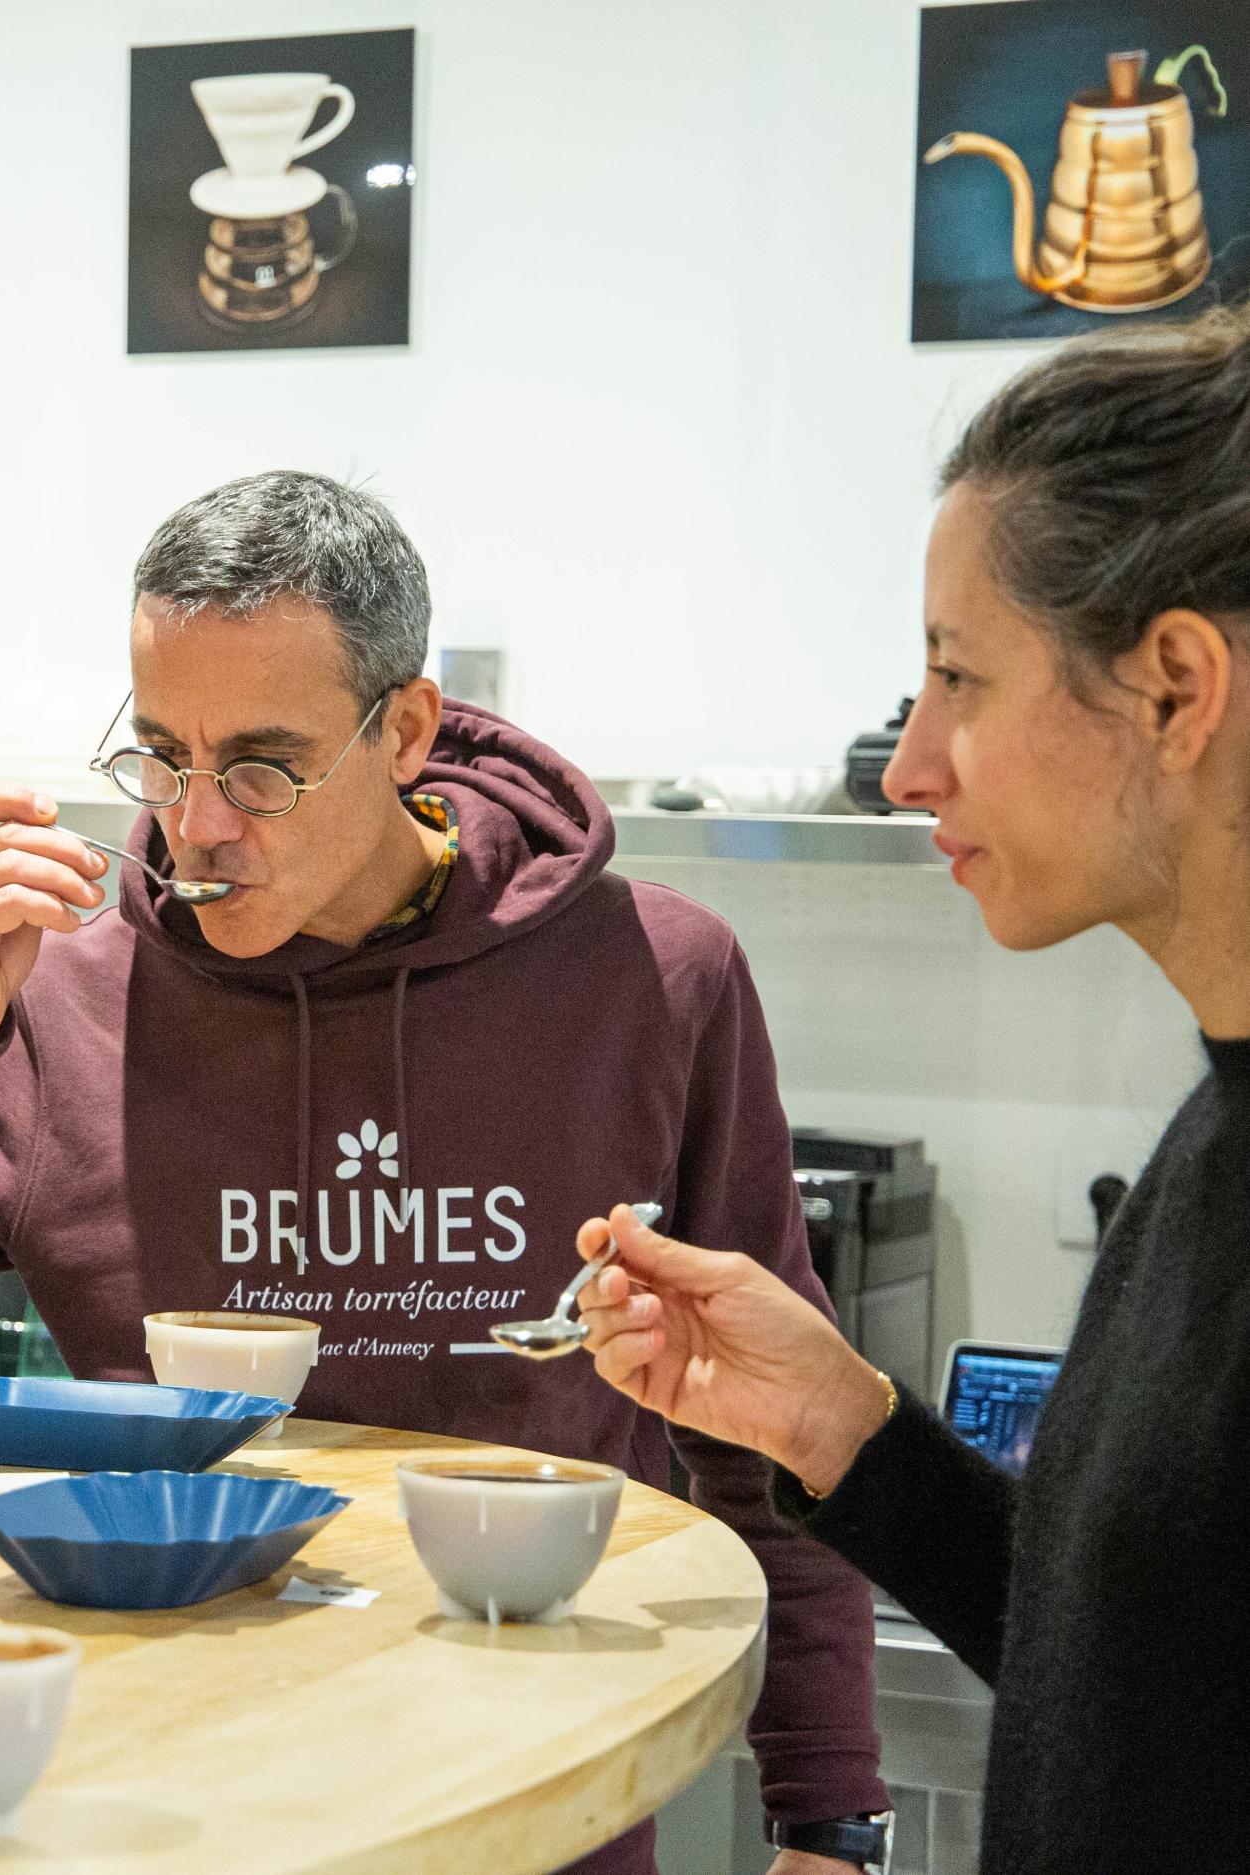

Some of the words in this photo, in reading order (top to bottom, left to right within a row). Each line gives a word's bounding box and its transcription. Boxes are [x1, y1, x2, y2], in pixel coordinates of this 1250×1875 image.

[221, 1185, 527, 1266] BRUMES
[222, 1279, 333, 1312] Artisan
[344, 1279, 526, 1320] torréfacteur
[317, 1342, 343, 1356] ac
